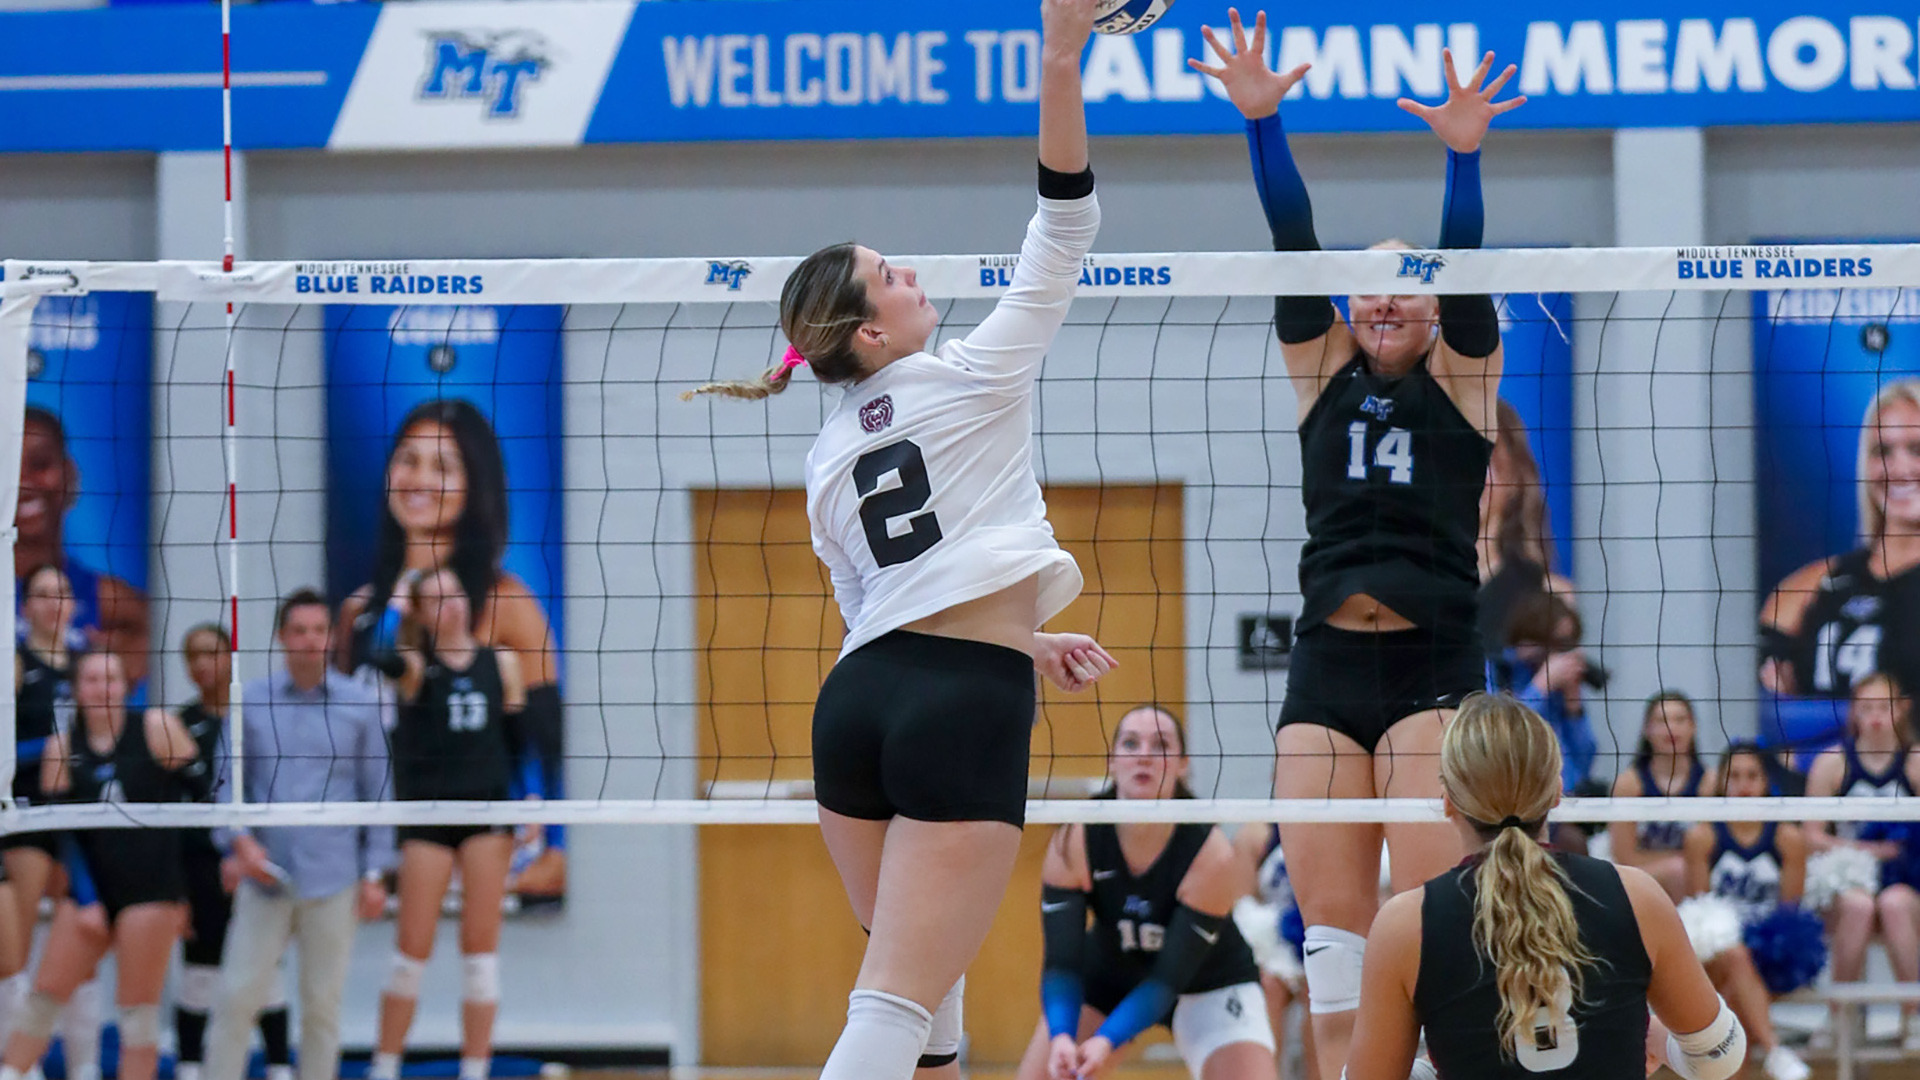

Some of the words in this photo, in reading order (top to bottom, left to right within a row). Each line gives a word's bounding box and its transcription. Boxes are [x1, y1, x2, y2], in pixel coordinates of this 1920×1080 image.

[662, 31, 948, 107] WELCOME
[964, 30, 1042, 103] TO
[1519, 15, 1920, 95] MEMOR
[1677, 247, 1720, 259] MIDDLE
[1727, 246, 1795, 258] TENNESSEE
[296, 264, 337, 274] MIDDLE
[344, 263, 409, 274] TENNESSEE
[704, 260, 753, 291] MT
[980, 268, 1015, 287] BL
[1077, 266, 1171, 286] AIDERS
[1397, 253, 1447, 284] MT
[1678, 260, 1743, 279] BLUE
[1755, 257, 1873, 278] RAIDERS
[296, 276, 359, 293] BLUE
[371, 275, 483, 294] RAIDERS
[1347, 420, 1413, 485] 14
[851, 438, 943, 568] 2
[1813, 620, 1884, 692] 14
